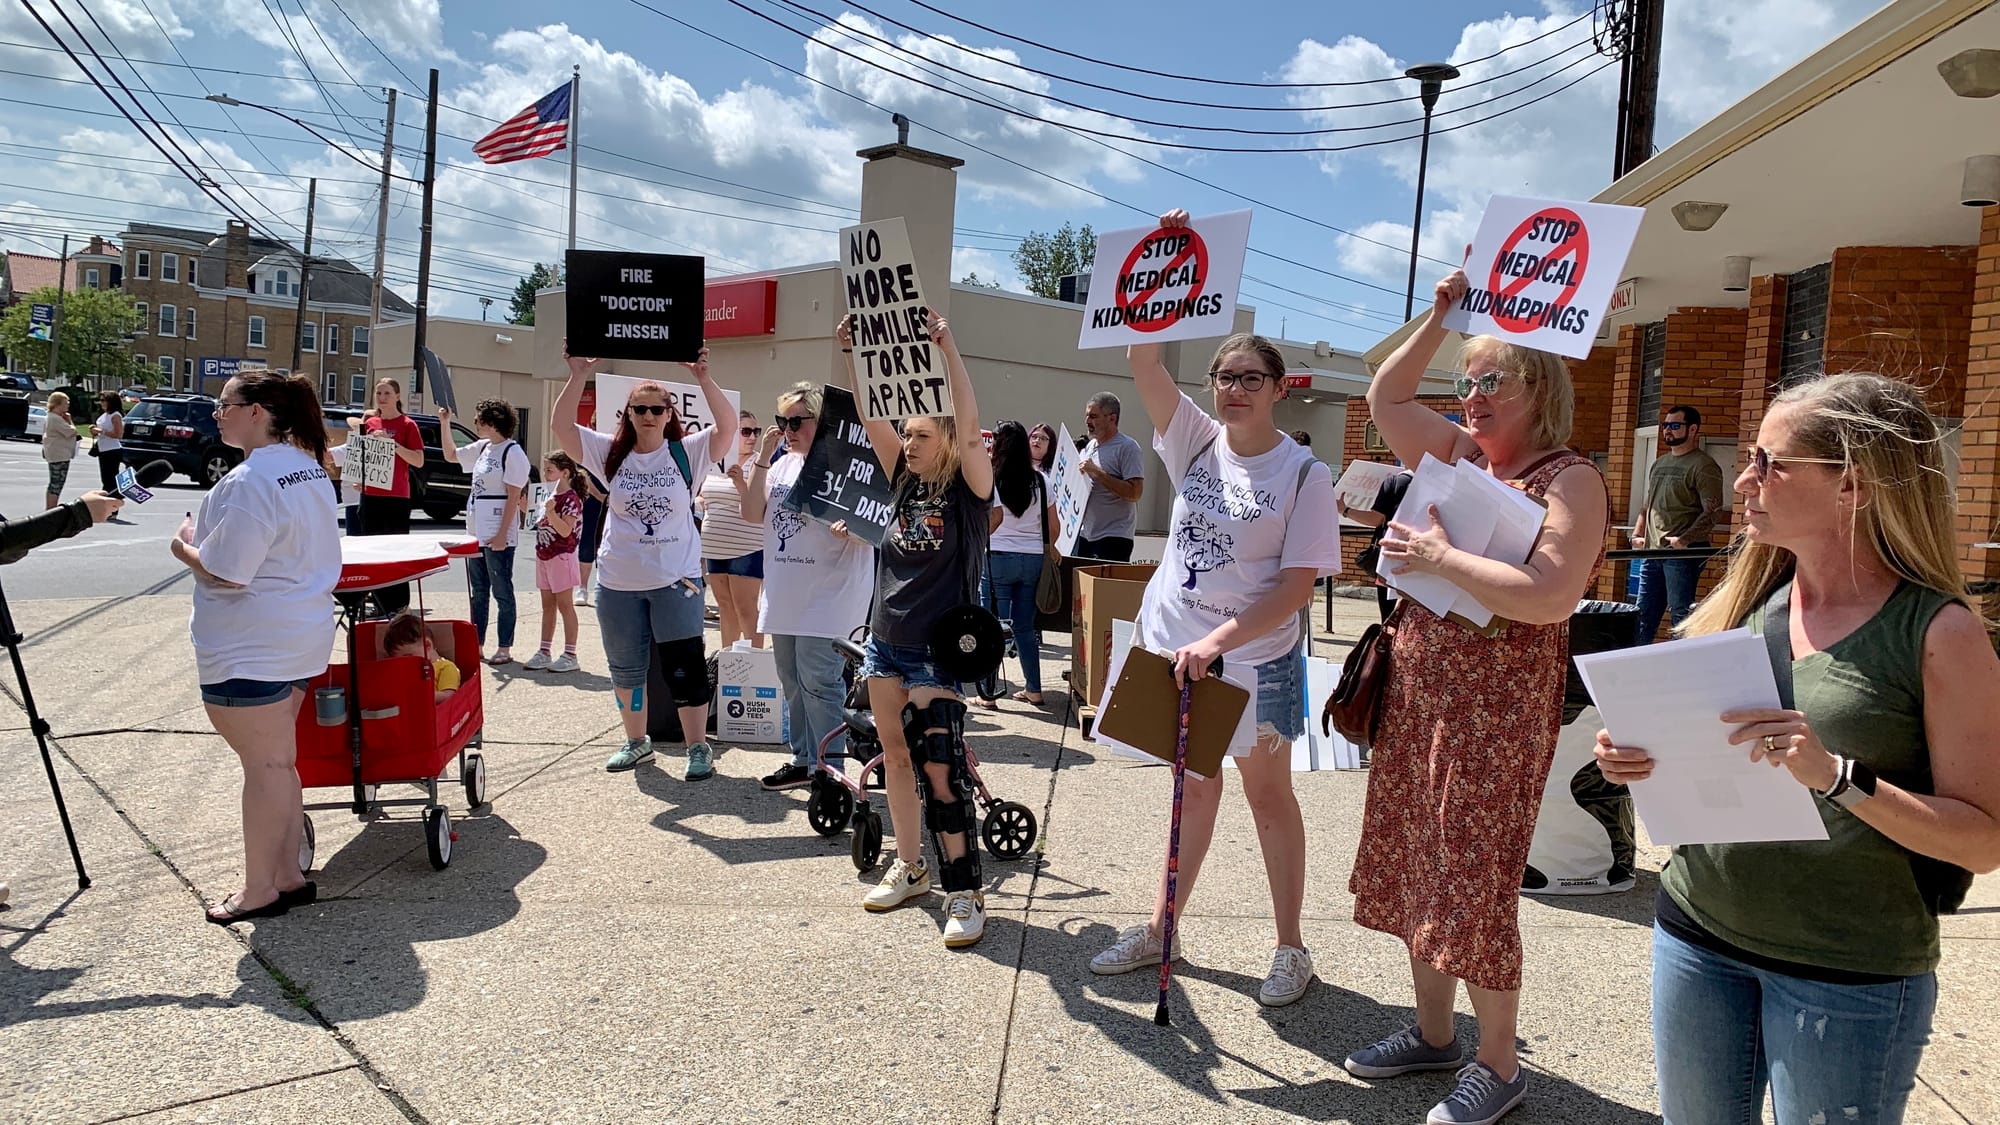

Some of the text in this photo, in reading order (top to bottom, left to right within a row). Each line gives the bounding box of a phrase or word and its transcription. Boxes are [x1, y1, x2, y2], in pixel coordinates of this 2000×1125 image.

[1528, 216, 1579, 244] STOP
[850, 229, 881, 266] NO
[1142, 234, 1190, 260] STOP
[620, 268, 653, 284] FIRE
[1118, 264, 1200, 294] MEDICAL
[1495, 250, 1578, 286] MEDICAL
[847, 264, 919, 309] MORE
[1610, 287, 1632, 311] ONLY
[600, 296, 673, 312] "DOCTOR"
[704, 299, 738, 321] ander
[1092, 293, 1223, 329] KIDNAPPINGS
[1460, 287, 1589, 334] KIDNAPPINGS
[604, 323, 670, 340] JENSSEN
[850, 306, 933, 347] FAMILIES
[861, 344, 931, 379] TORN
[868, 377, 945, 418] APART
[837, 420, 844, 439] I
[345, 448, 360, 463] THE
[369, 467, 388, 484] CYS
[647, 477, 676, 488] GROUP
[848, 458, 875, 485] FOR
[854, 495, 892, 527] DAYS
[1059, 484, 1072, 521] THE
[1217, 499, 1262, 523] GROUP
[1066, 500, 1080, 539] CAC
[1196, 599, 1222, 615] Families
